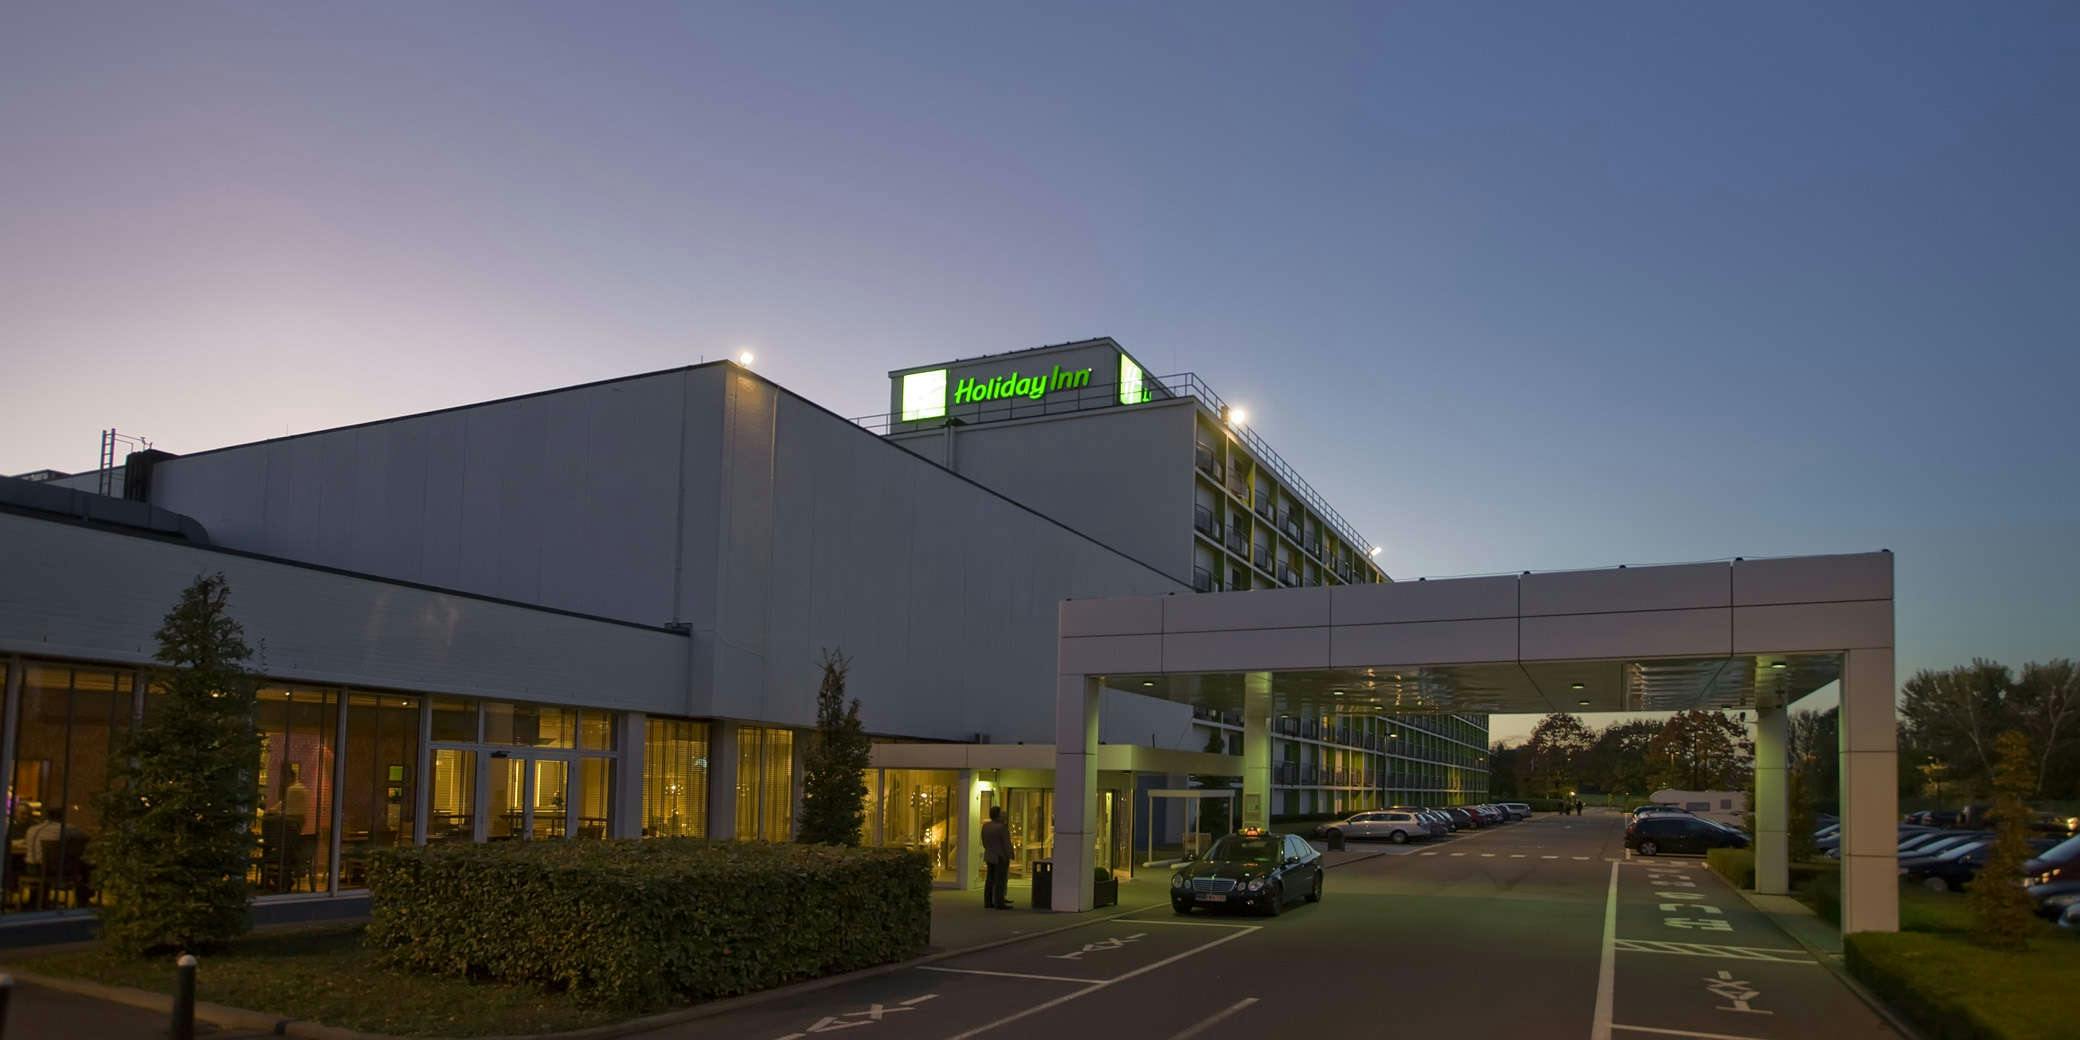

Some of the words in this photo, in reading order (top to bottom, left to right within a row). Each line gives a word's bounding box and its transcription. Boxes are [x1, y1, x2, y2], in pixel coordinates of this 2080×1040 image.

[954, 371, 1048, 404] Holiday
[1049, 364, 1090, 392] Inn
[1704, 971, 1773, 1014] TAXI
